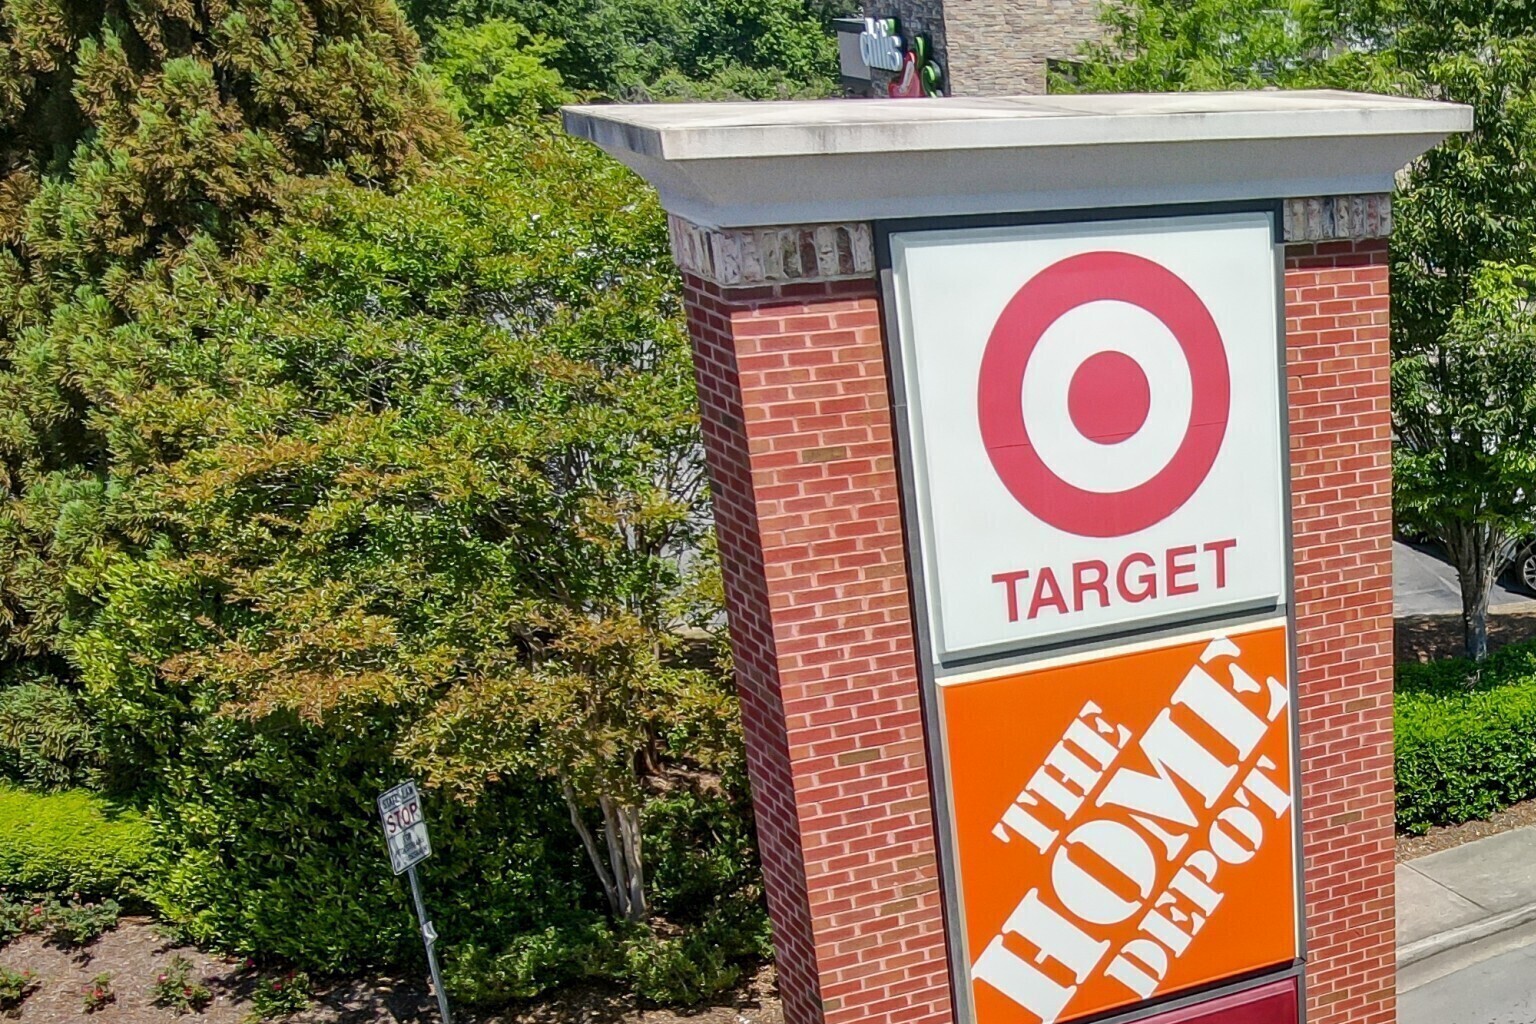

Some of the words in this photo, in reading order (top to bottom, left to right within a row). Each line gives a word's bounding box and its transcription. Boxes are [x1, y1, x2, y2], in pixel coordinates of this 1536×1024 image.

[991, 538, 1238, 623] TARGET
[387, 802, 418, 834] STOP
[991, 699, 1133, 855] THE
[1103, 754, 1291, 1000] DEPOT
